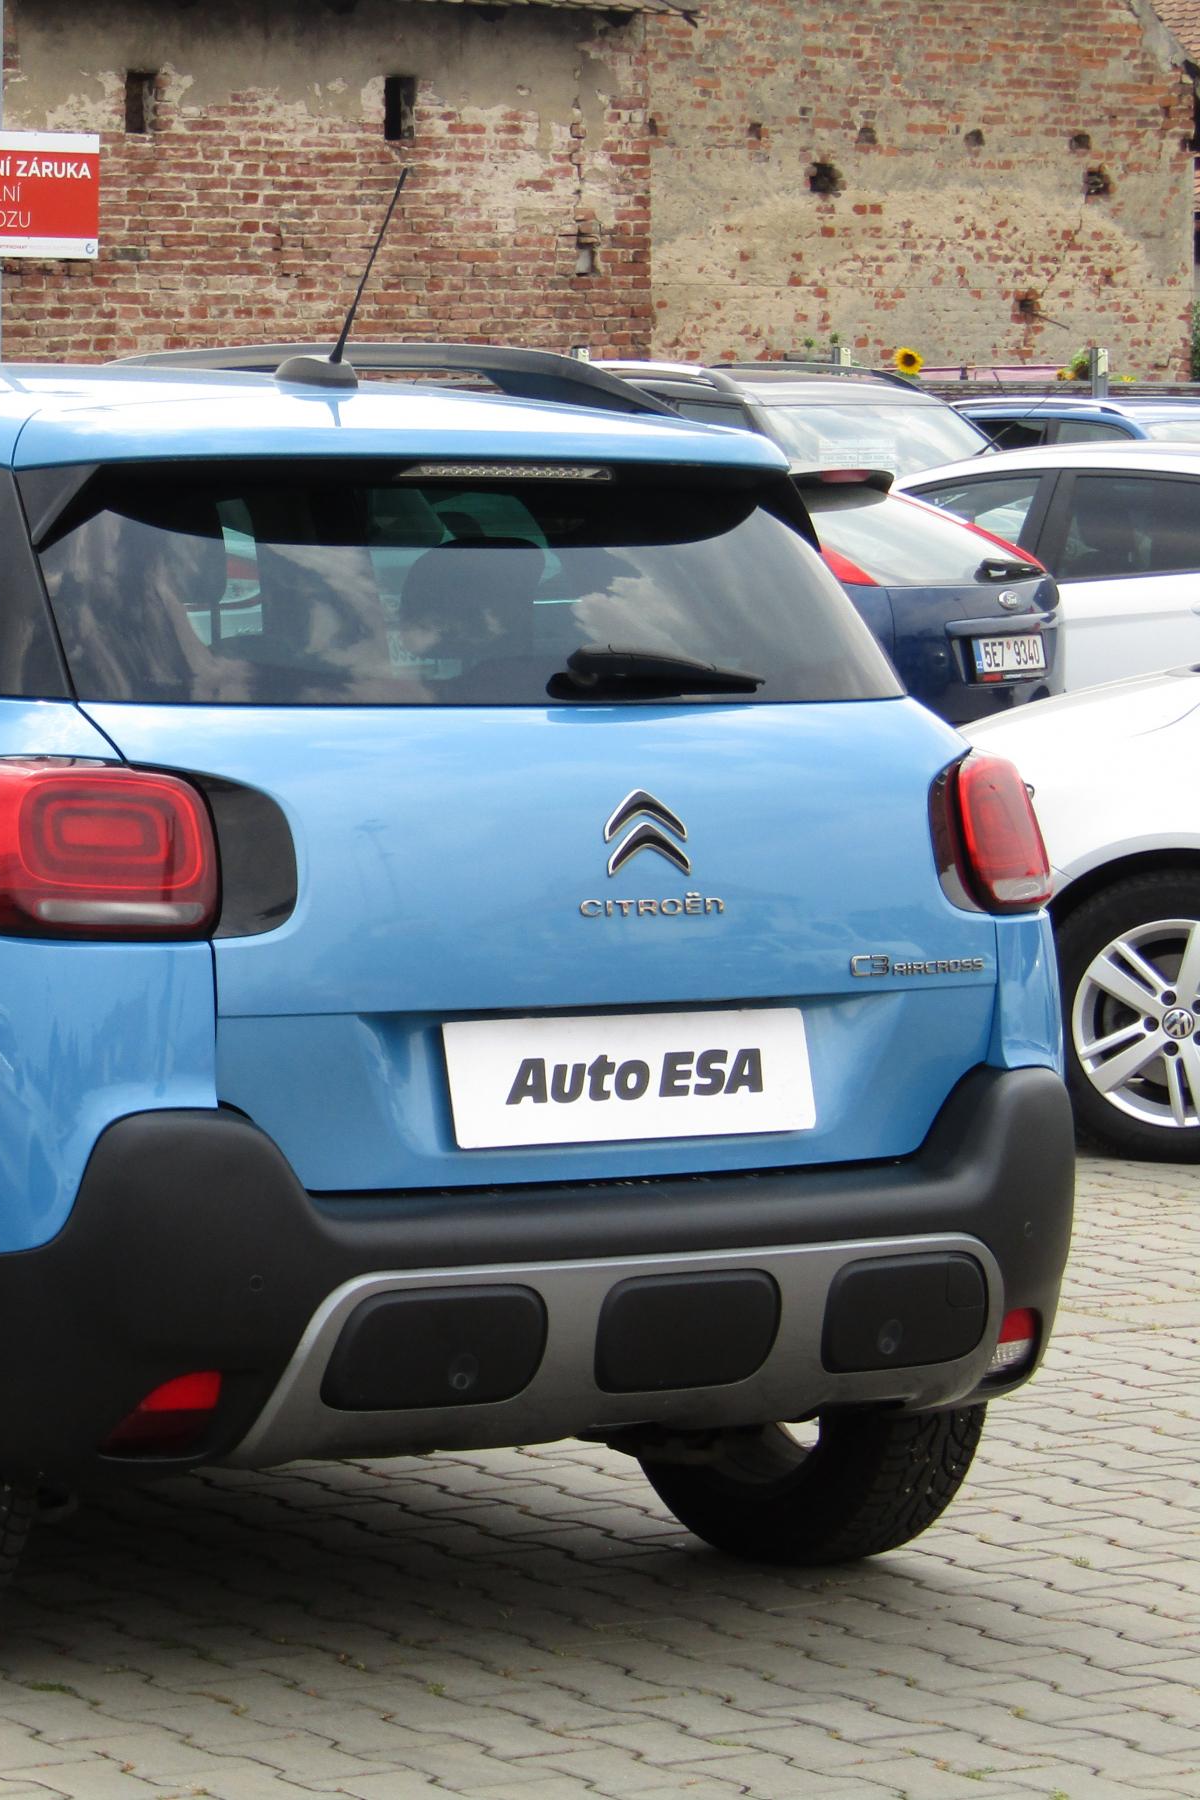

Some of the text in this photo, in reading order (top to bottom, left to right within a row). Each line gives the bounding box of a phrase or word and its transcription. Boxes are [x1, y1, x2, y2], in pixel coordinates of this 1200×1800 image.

[16, 157, 92, 179] ZÁRUKA
[983, 639, 1040, 669] 5E7 9340
[851, 954, 984, 977] C3 AIRCROSS
[505, 1048, 764, 1105] Auto ESA
